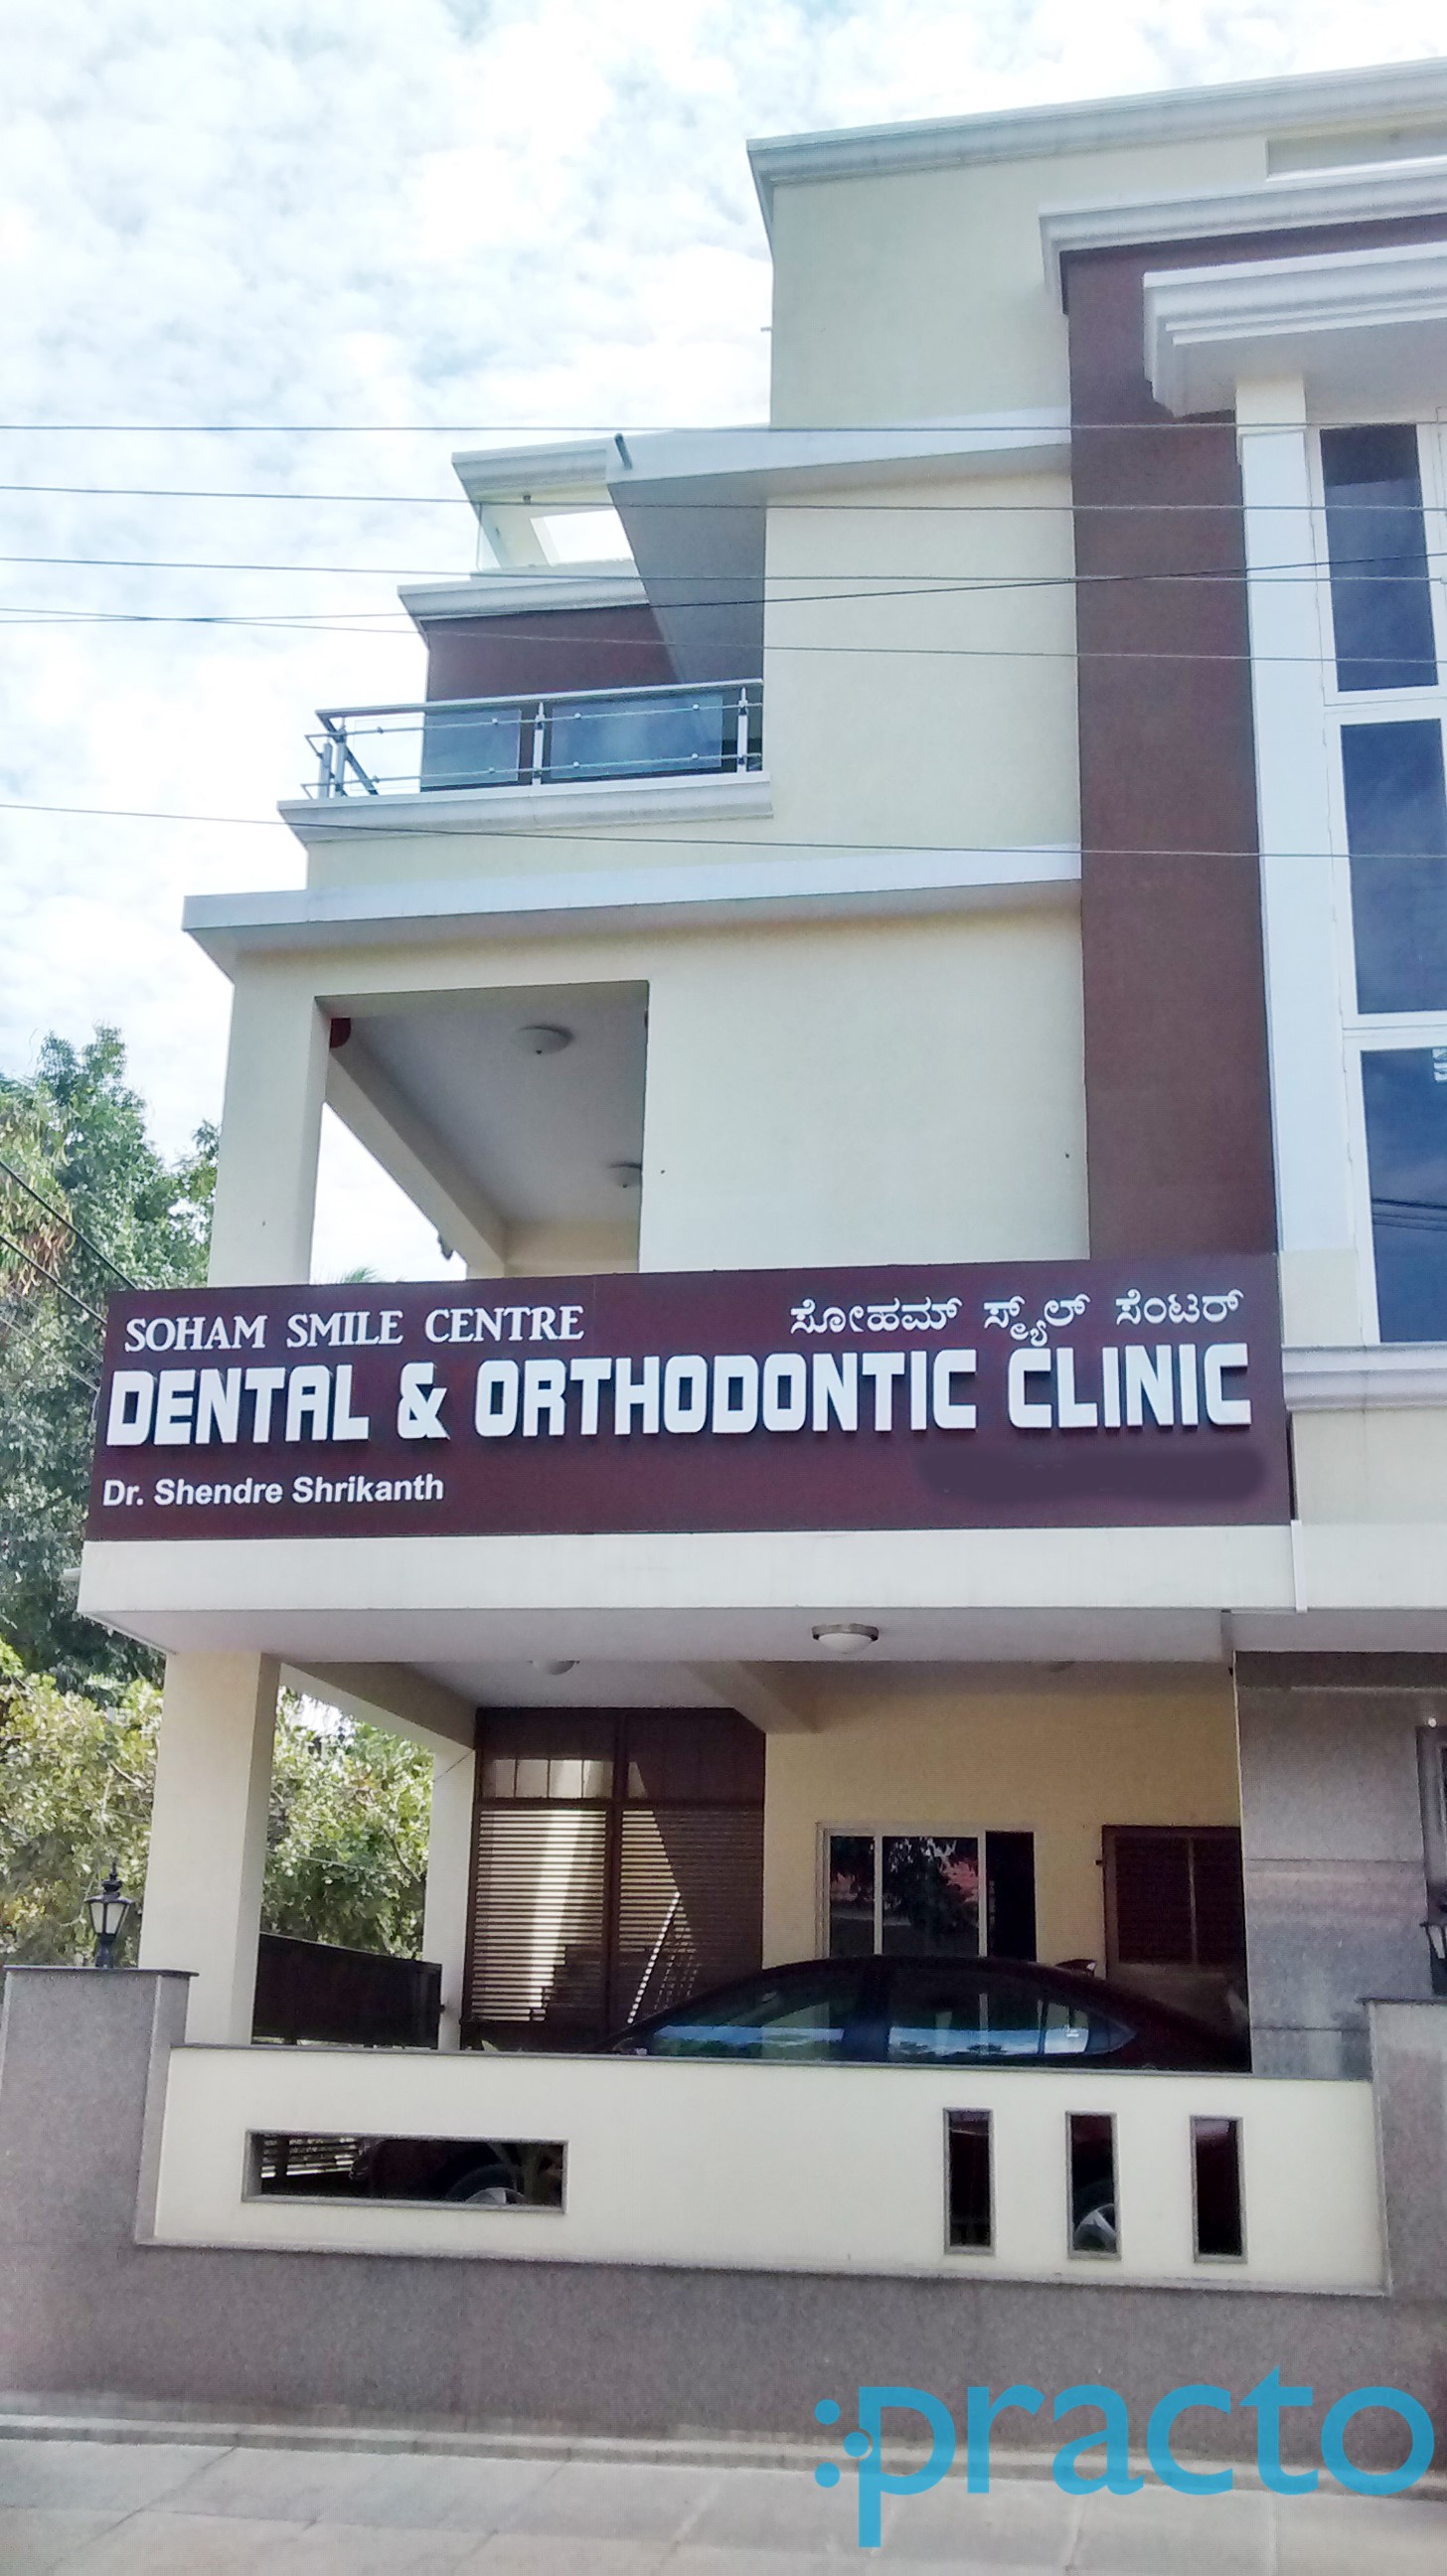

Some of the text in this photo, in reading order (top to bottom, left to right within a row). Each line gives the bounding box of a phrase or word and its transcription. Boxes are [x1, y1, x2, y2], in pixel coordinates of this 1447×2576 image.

[124, 1305, 584, 1353] SOHAM SMILE CENTRE
[790, 1296, 963, 1335] ಸೋಹಮ್
[1115, 1288, 1244, 1326] ಸೆಂಟರ್
[105, 1342, 1252, 1446] DENTAL & ORTHODONTIC CLINIC
[102, 1473, 444, 1507] Dr. Shendre Shrikanth
